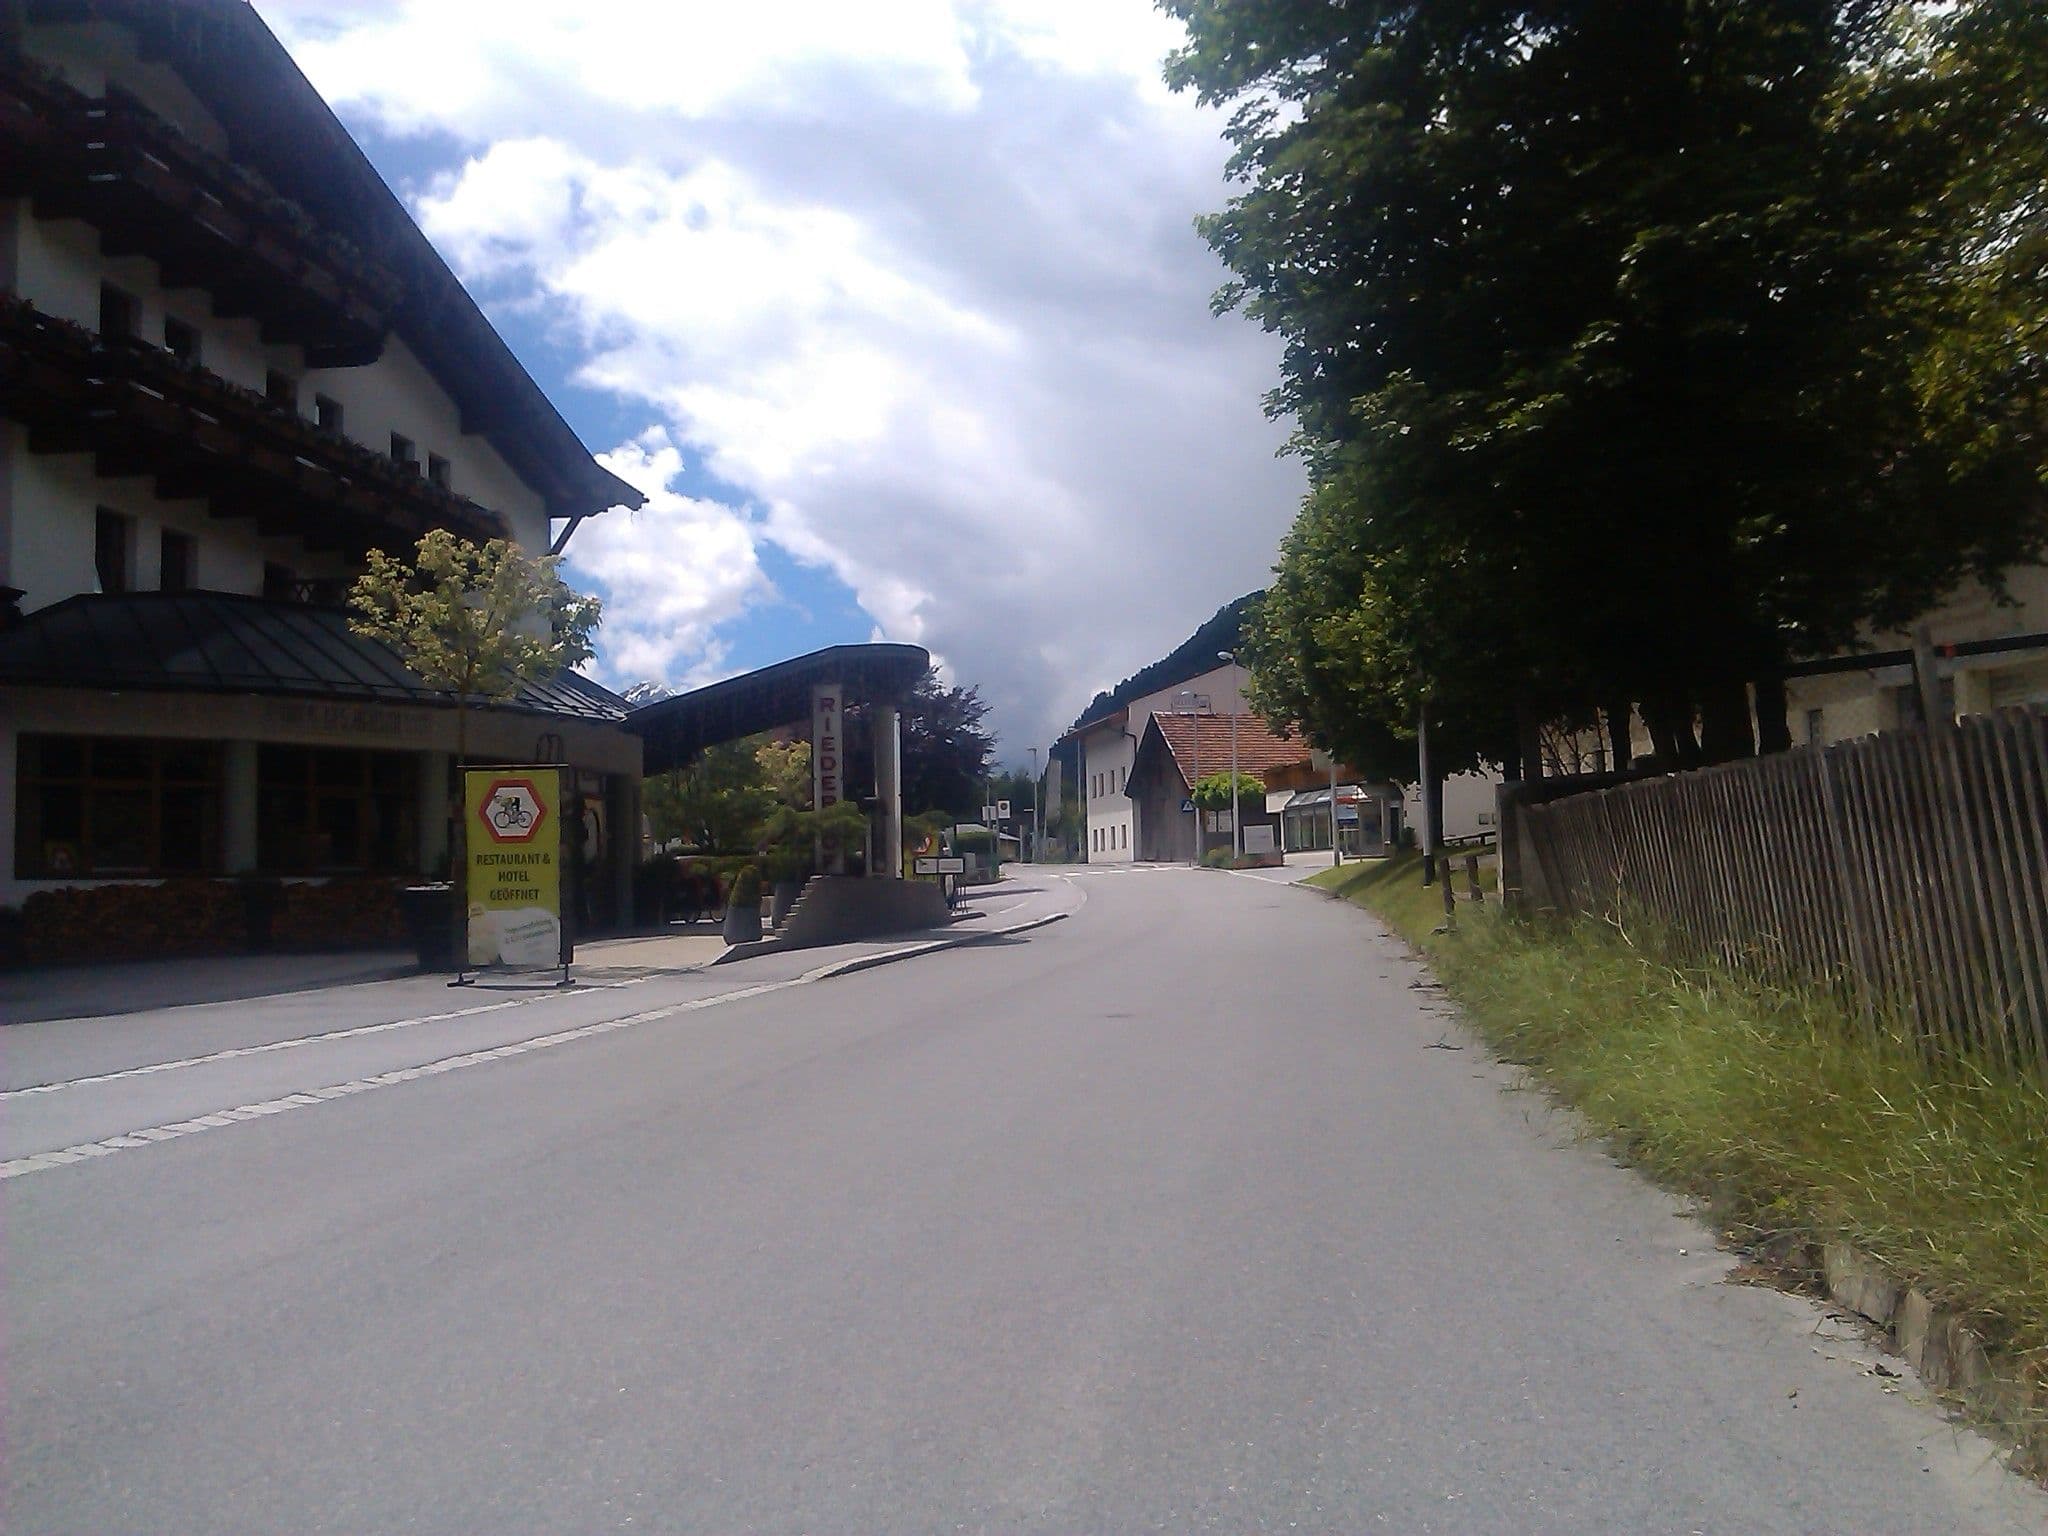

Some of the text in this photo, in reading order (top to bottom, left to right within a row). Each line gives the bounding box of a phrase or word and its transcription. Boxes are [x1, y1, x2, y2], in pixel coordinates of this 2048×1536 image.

[476, 853, 551, 865] RESTAURANT &
[498, 871, 530, 882] HOTEL
[490, 887, 540, 900] GEÖFFNET
